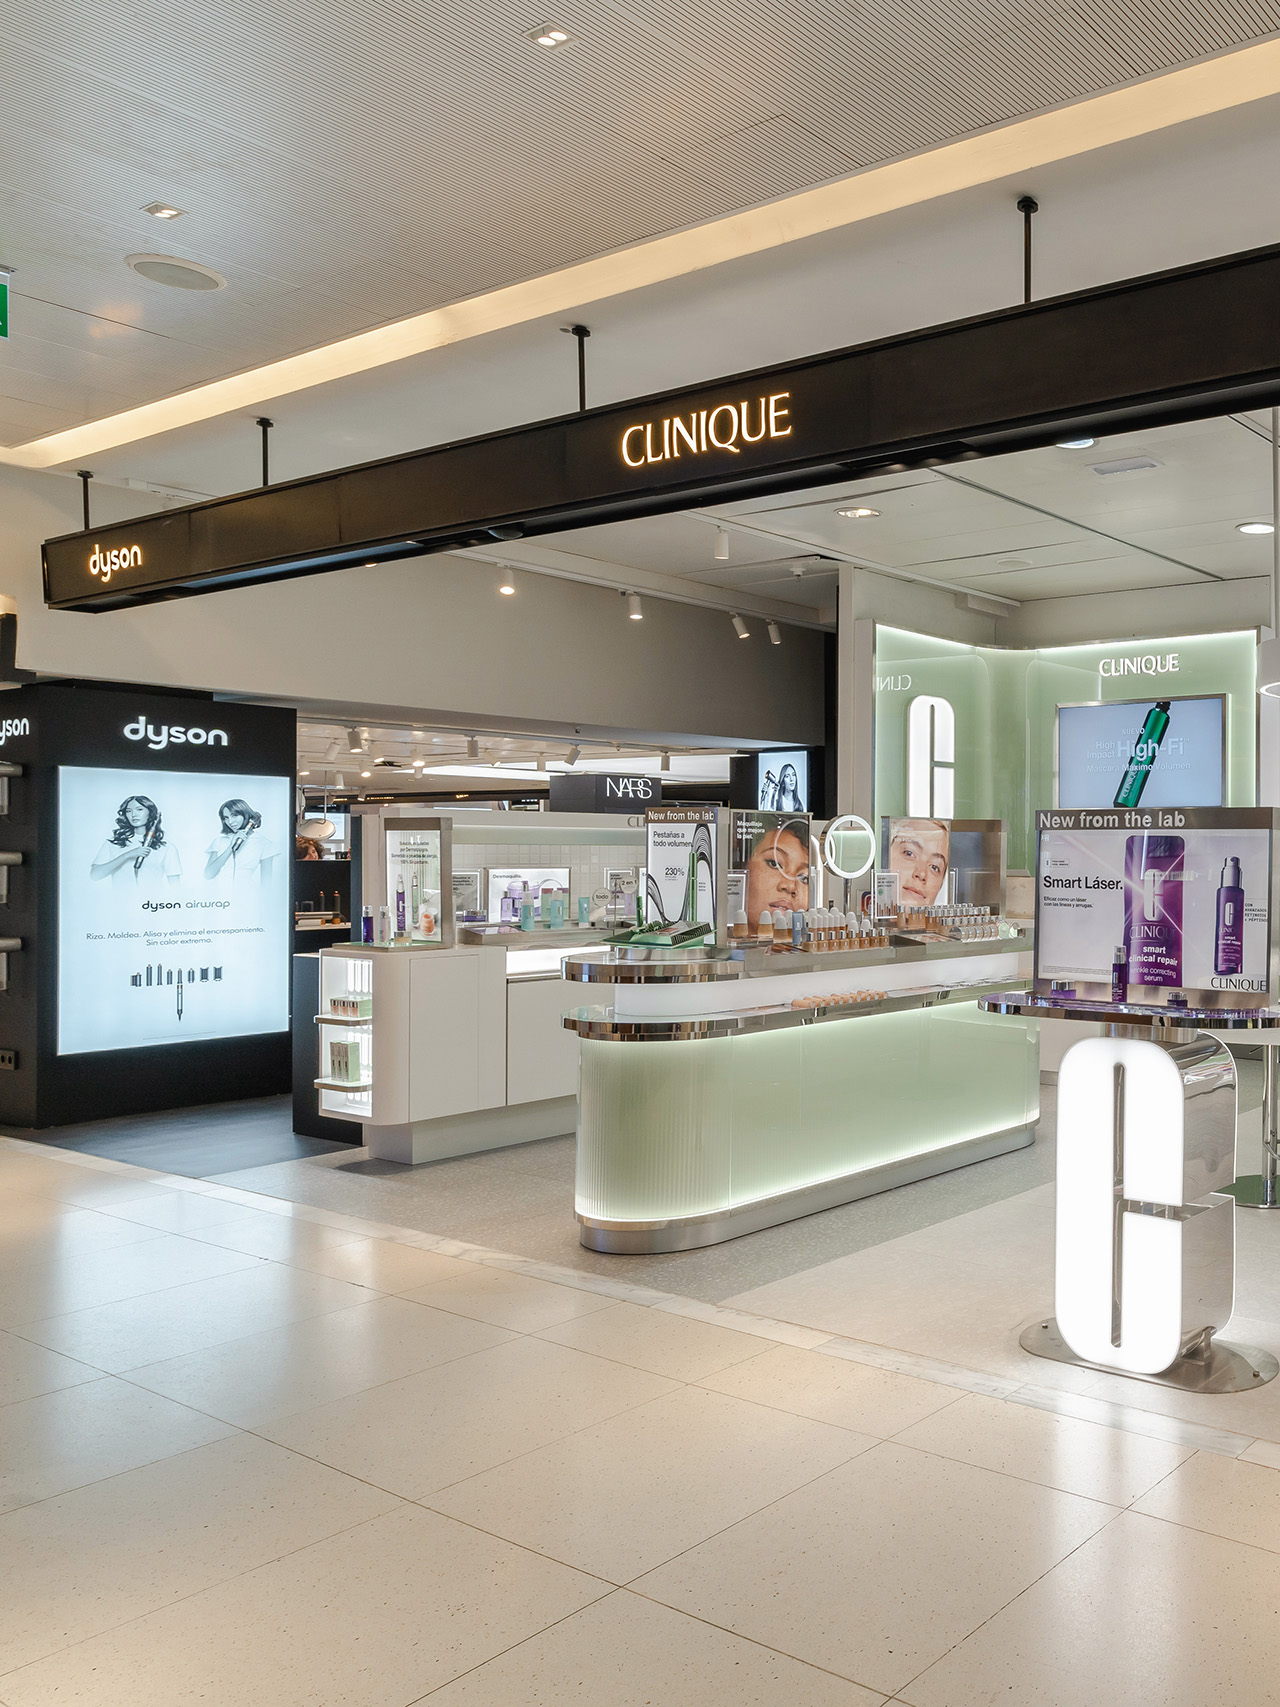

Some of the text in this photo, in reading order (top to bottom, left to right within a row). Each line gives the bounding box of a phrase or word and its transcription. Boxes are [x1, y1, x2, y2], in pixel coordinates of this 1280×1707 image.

[622, 392, 792, 467] CLINIQUE
[89, 544, 142, 582] dyson
[1099, 653, 1180, 677] CLINIQUE
[123, 716, 228, 750] dyson
[1087, 751, 1116, 759] Impact
[606, 777, 652, 799] NARS
[648, 811, 714, 820] New from the lab
[1040, 811, 1185, 828] New from the lab
[1043, 875, 1123, 890] Smart Láser.
[142, 900, 230, 912] dyson airwrap
[169, 928, 197, 937] elimina
[206, 926, 266, 935] encrespamiento.
[180, 937, 213, 945] extremo.
[1158, 956, 1178, 966] repair
[1150, 968, 1176, 978] correcting
[1211, 977, 1267, 991] CLINIQUE
